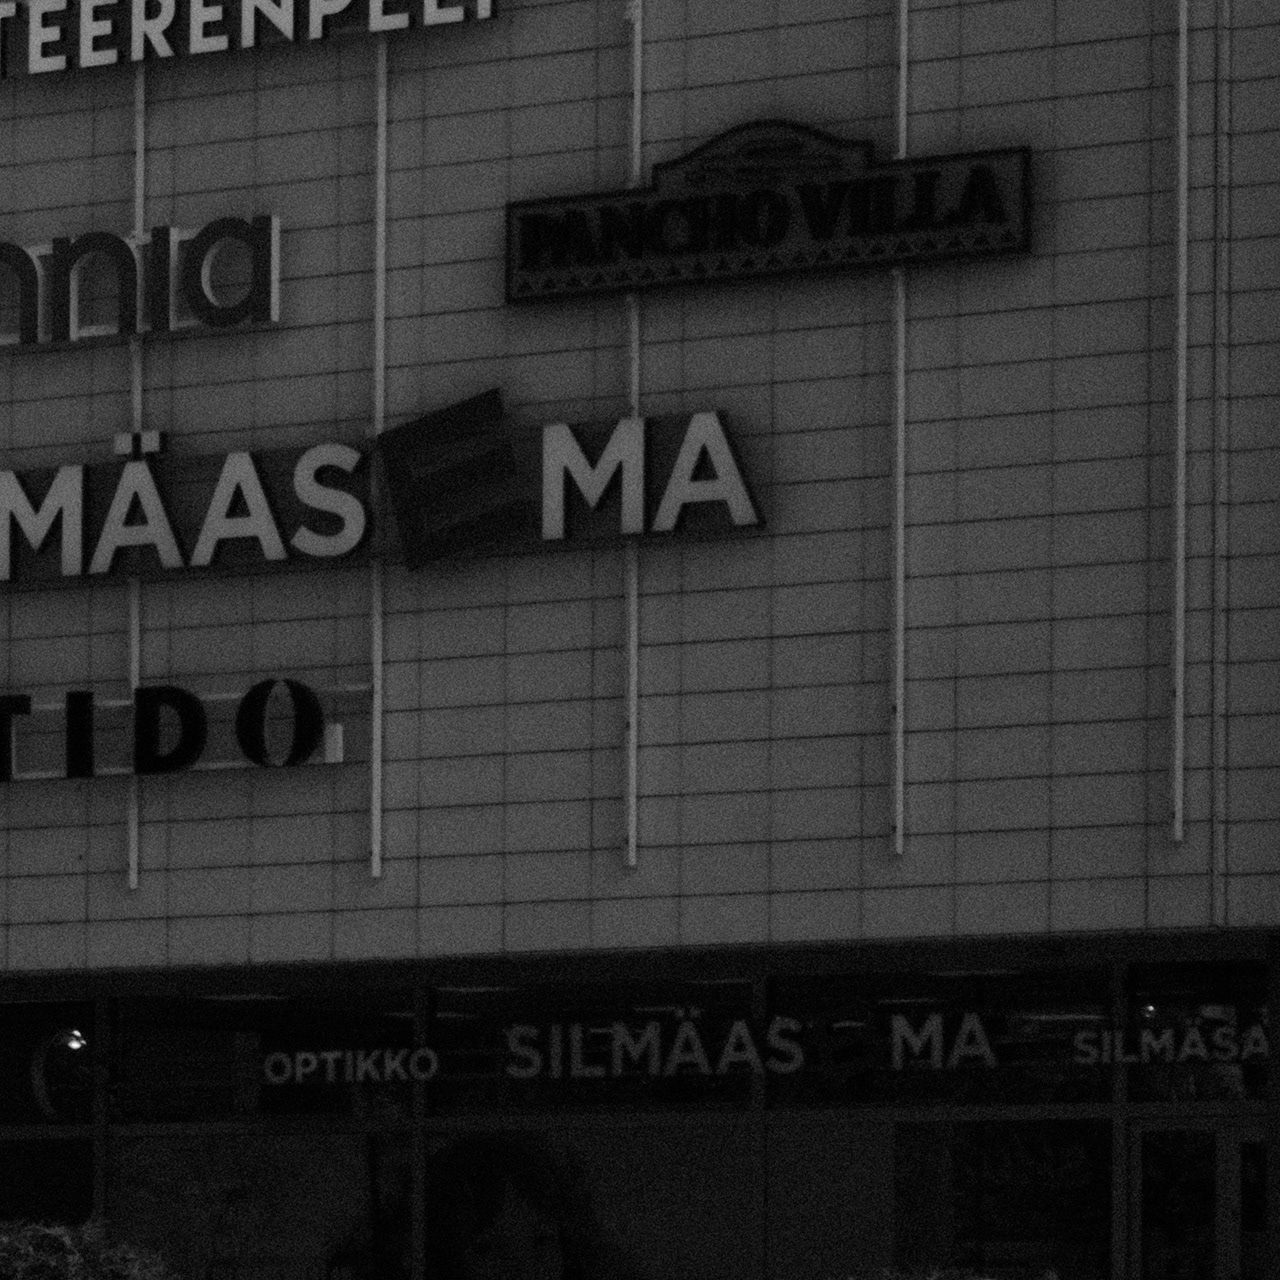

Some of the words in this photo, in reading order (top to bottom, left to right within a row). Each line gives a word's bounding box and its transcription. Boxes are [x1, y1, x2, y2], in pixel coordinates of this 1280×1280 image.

[517, 190, 790, 270] PANCHO
[795, 165, 1008, 240] VILLA
[263, 1047, 440, 1085] OPTIKKO
